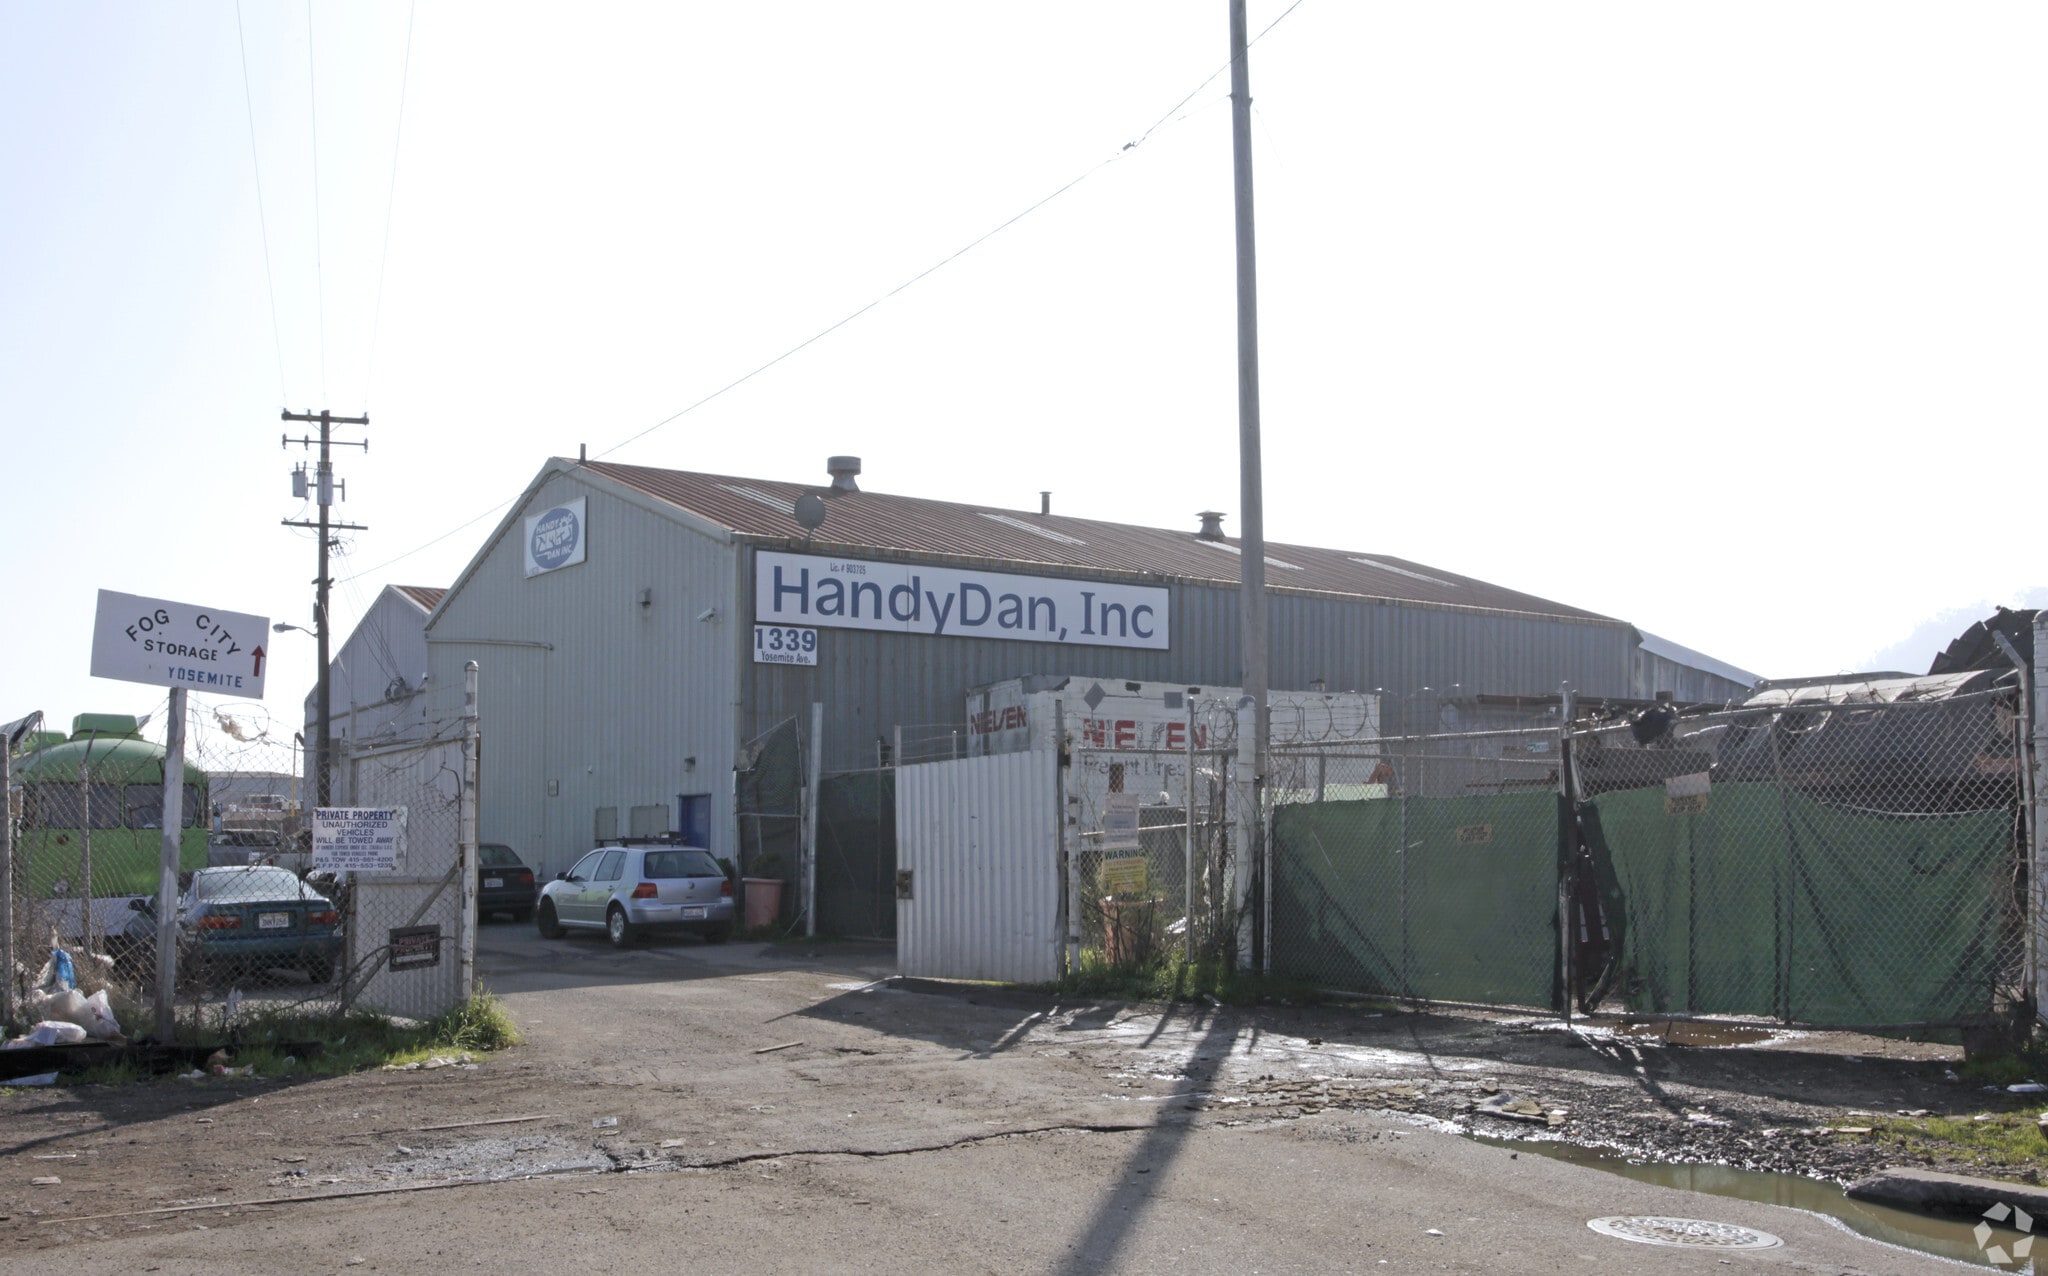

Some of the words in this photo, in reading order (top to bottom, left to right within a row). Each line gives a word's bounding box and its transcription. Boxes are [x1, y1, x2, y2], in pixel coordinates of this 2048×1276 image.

[536, 518, 560, 533] HANDY
[547, 549, 561, 560] DAN
[561, 544, 572, 555] INC
[830, 562, 840, 572] Lic.
[773, 565, 1067, 641] HandyDan,
[1080, 591, 1154, 639] Inc
[125, 609, 170, 642] FOG
[196, 614, 241, 655] CITY
[755, 627, 816, 652] 1339
[144, 639, 218, 661] STORAGE
[761, 650, 795, 663] Yosemite
[796, 653, 811, 664] Ave.
[168, 666, 243, 688] YOSEMITE
[316, 810, 349, 820] PRIVATE
[352, 810, 394, 820] PROPERTY
[322, 821, 388, 829] UNAUTHORIZED
[337, 828, 375, 836] VEHICLES
[316, 836, 333, 844] WILL
[335, 836, 345, 844] BE
[348, 836, 374, 844] TOWED
[375, 836, 394, 844] AWAY
[1104, 848, 1145, 860] WARNING
